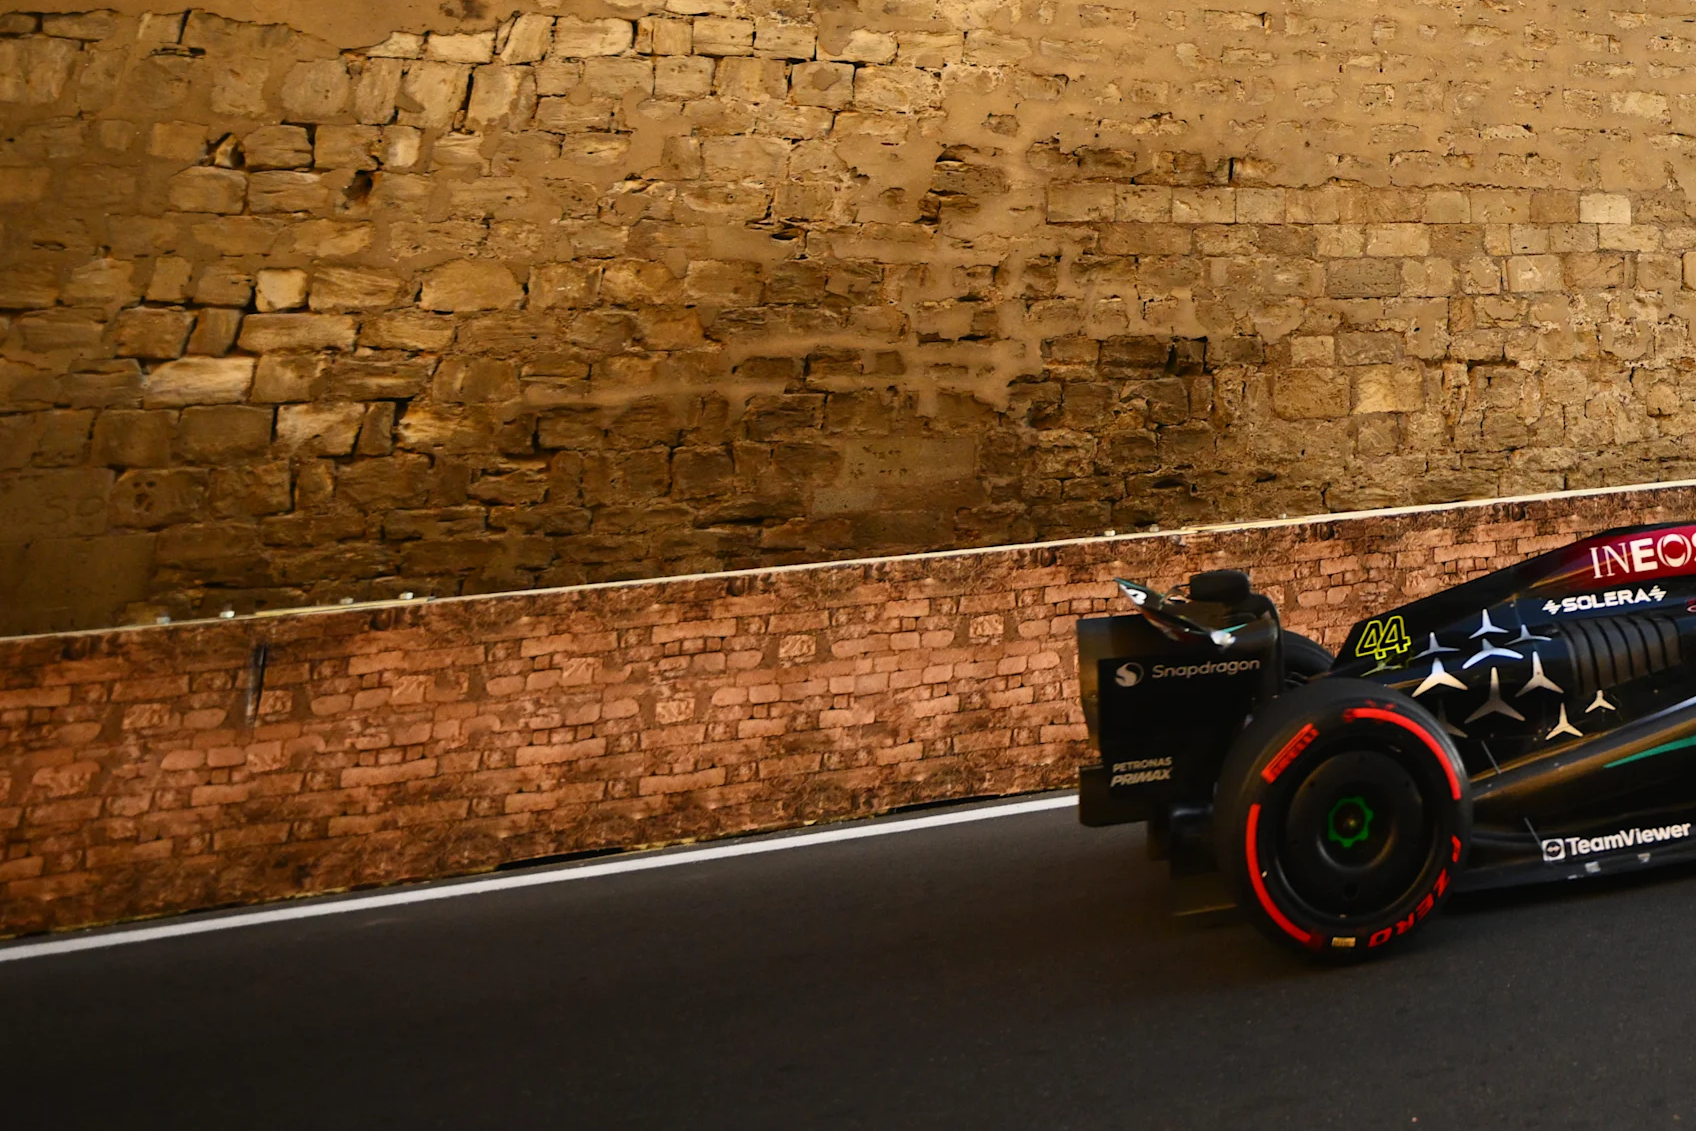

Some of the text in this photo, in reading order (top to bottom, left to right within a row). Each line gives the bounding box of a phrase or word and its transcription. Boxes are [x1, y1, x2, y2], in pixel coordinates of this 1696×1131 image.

[1560, 588, 1650, 613] SOLERA
[1355, 615, 1411, 660] 44
[1152, 658, 1261, 680] Snapdragon
[1110, 766, 1174, 787] PRIMAX
[1112, 756, 1173, 773] PETRONAS
[1565, 822, 1692, 856] TeamViewer
[1368, 868, 1450, 947] ZERO
